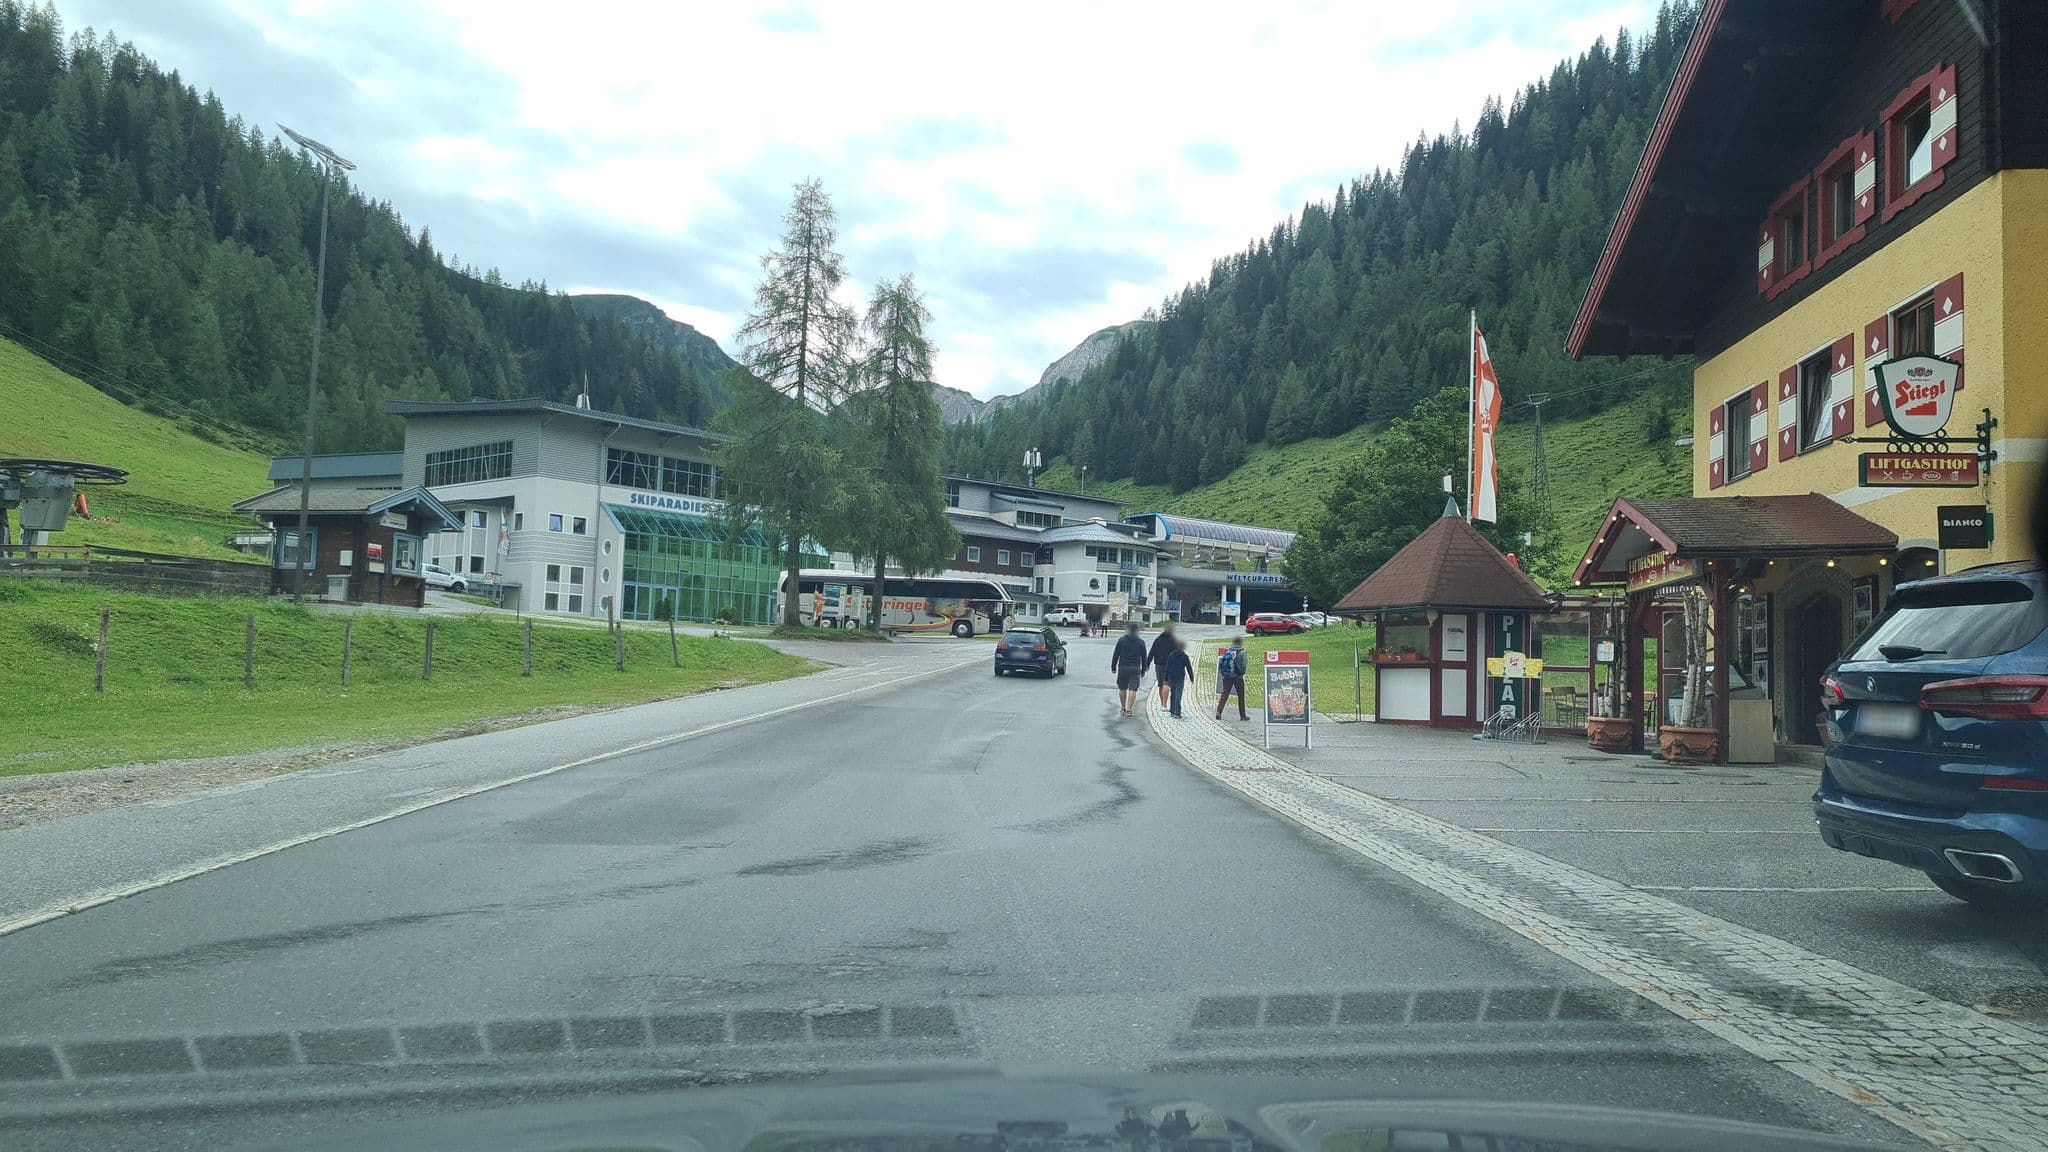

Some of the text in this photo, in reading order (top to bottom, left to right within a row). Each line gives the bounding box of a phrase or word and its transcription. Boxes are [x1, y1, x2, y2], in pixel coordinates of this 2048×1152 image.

[1895, 379, 1945, 408] Stiegl
[1870, 458, 1971, 469] LIFTGASTHOF
[1943, 519, 1983, 527] BIANCO
